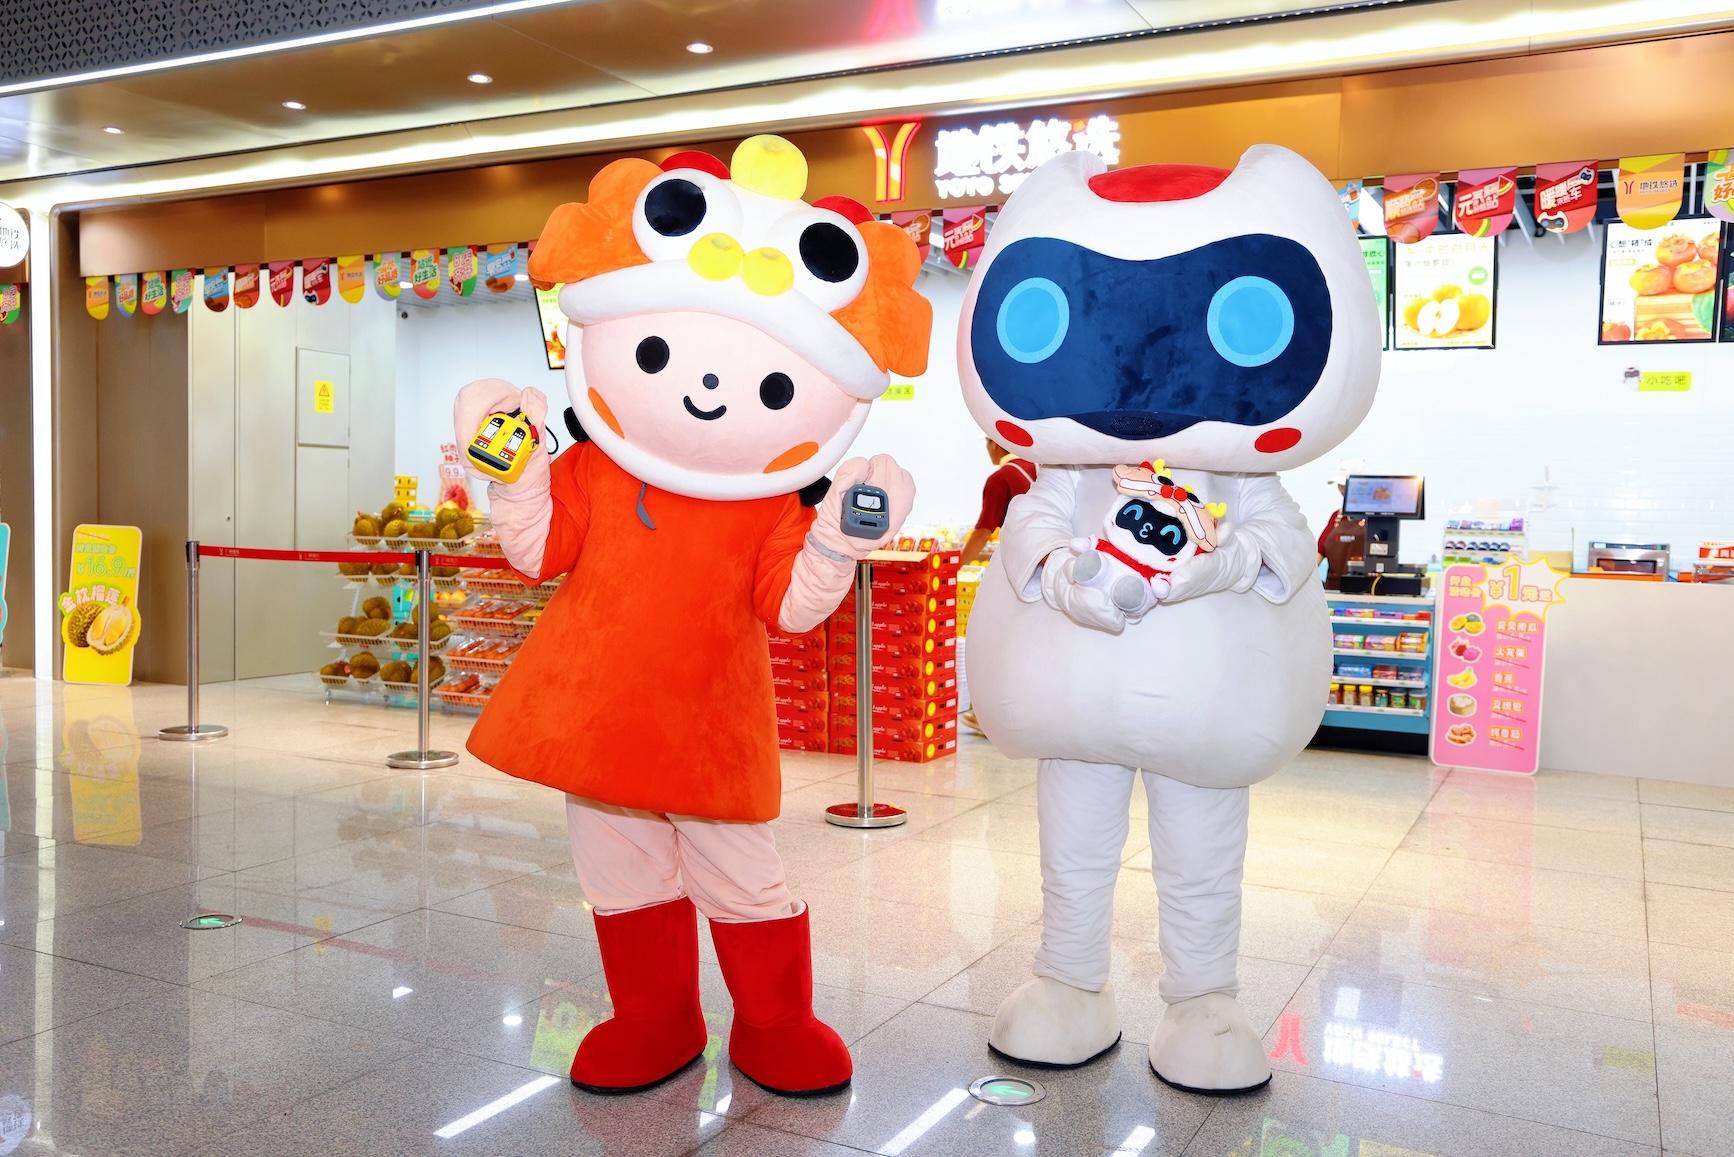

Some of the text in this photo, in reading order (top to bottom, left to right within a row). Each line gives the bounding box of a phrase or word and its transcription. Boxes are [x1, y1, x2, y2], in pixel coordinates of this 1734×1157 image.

[934, 176, 995, 200] YOYO
[1646, 375, 1686, 385] 小吃吧
[62, 584, 121, 614] 金枕榴莲
[1496, 620, 1538, 632] 贝贝南瓜
[1496, 646, 1526, 658] 火龙果
[1494, 673, 1514, 684] 香蕉
[1492, 700, 1523, 711] 叉烧包
